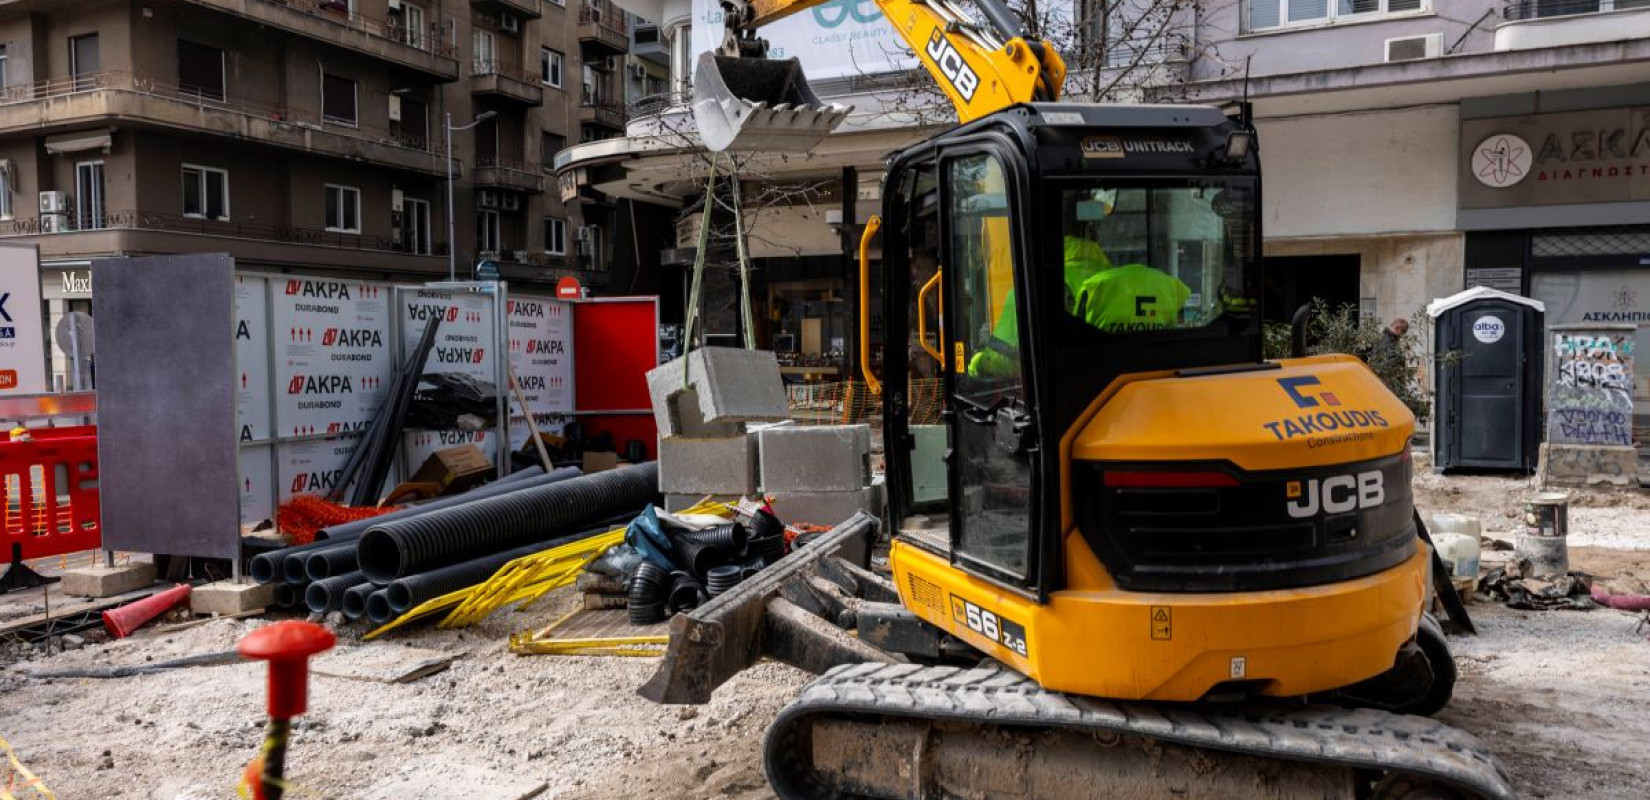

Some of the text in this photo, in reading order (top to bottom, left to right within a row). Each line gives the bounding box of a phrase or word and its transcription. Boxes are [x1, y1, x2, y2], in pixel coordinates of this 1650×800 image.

[812, 33, 850, 46] CLASSY
[851, 26, 888, 41] BEAUTY
[927, 36, 977, 101] JCB
[1083, 140, 1195, 153] JCB UNITRACK
[302, 279, 351, 301] AKPA
[295, 302, 340, 314] DURABOND
[513, 301, 545, 319] AKPA
[1474, 322, 1500, 331] alba
[337, 329, 383, 347] AKPA
[535, 340, 565, 354] AKPA
[330, 353, 372, 362] DURABOND
[436, 348, 475, 364] AKPA
[304, 375, 353, 395] AKPA
[297, 400, 342, 410] DURABOND
[1263, 409, 1390, 441] TAKOUDIS
[1306, 432, 1375, 450] Constructions
[1286, 469, 1385, 519] JCB
[965, 601, 1000, 642] 56
